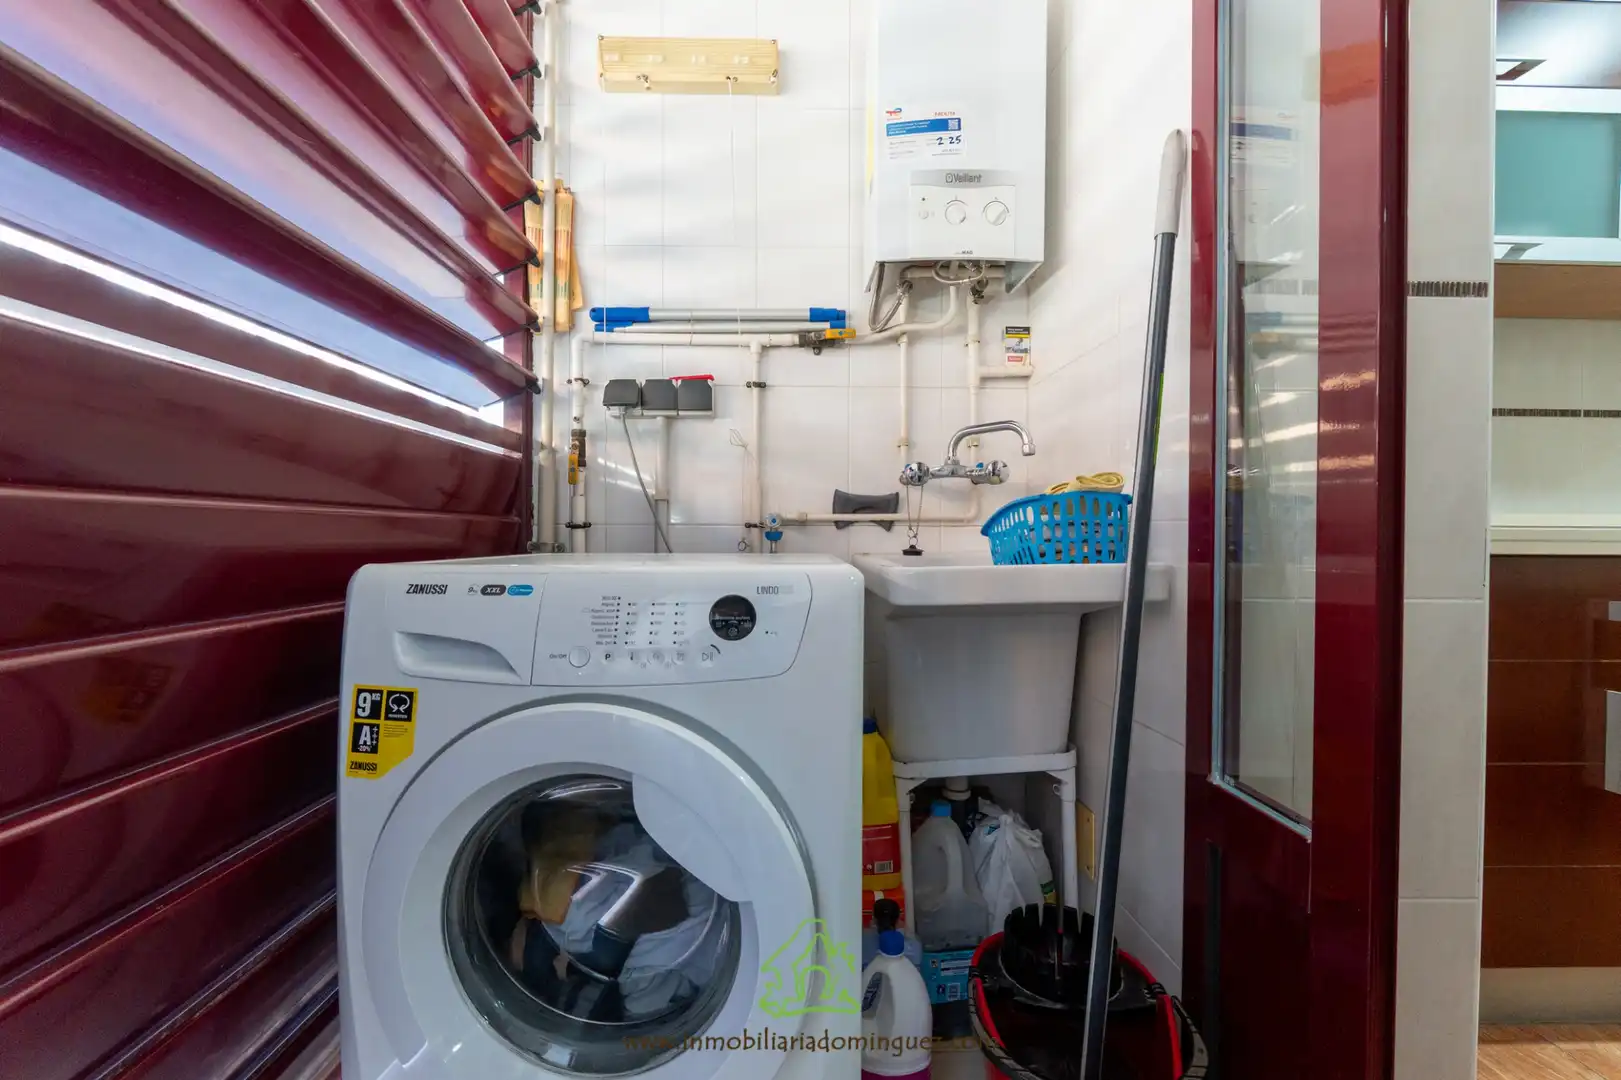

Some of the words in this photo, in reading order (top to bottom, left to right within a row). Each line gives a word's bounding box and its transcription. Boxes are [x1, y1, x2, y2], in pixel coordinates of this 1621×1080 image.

[953, 173, 982, 183] Vaillant
[406, 583, 448, 595] ZANUSSI
[756, 586, 779, 595] LINDO
[350, 760, 377, 772] ZANUSSI
